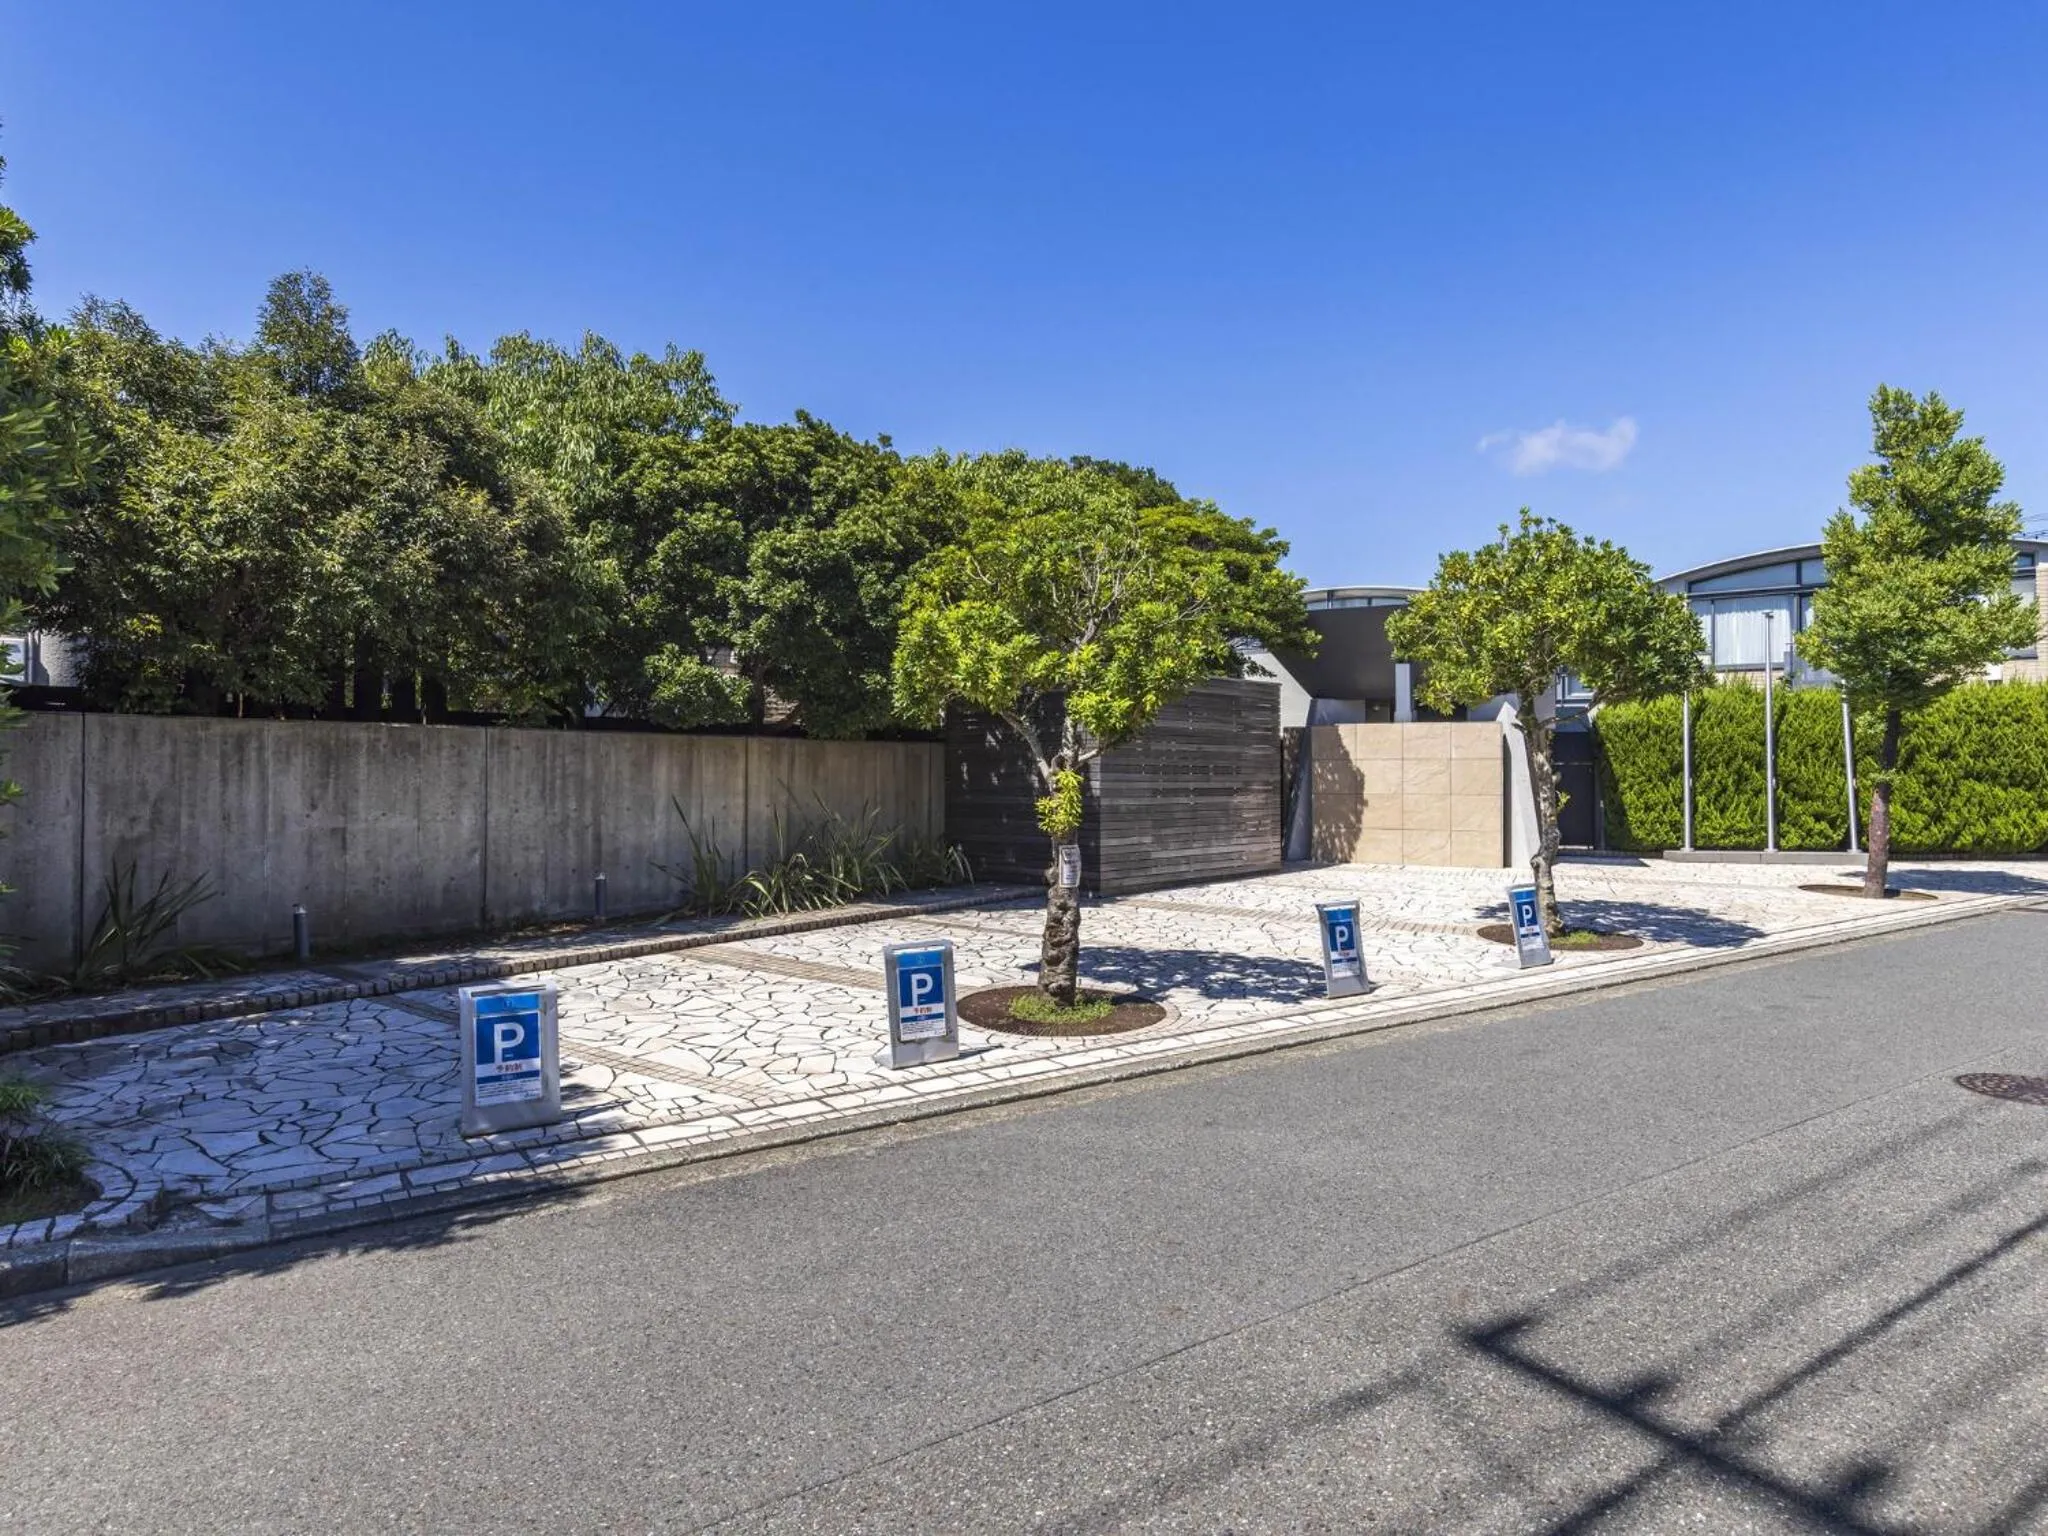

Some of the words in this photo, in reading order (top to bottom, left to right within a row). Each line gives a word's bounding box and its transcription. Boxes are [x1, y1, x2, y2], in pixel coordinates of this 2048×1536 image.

[1522, 904, 1533, 927] P
[1335, 925, 1349, 952] P
[911, 973, 934, 1007] P
[493, 1022, 525, 1064] P
